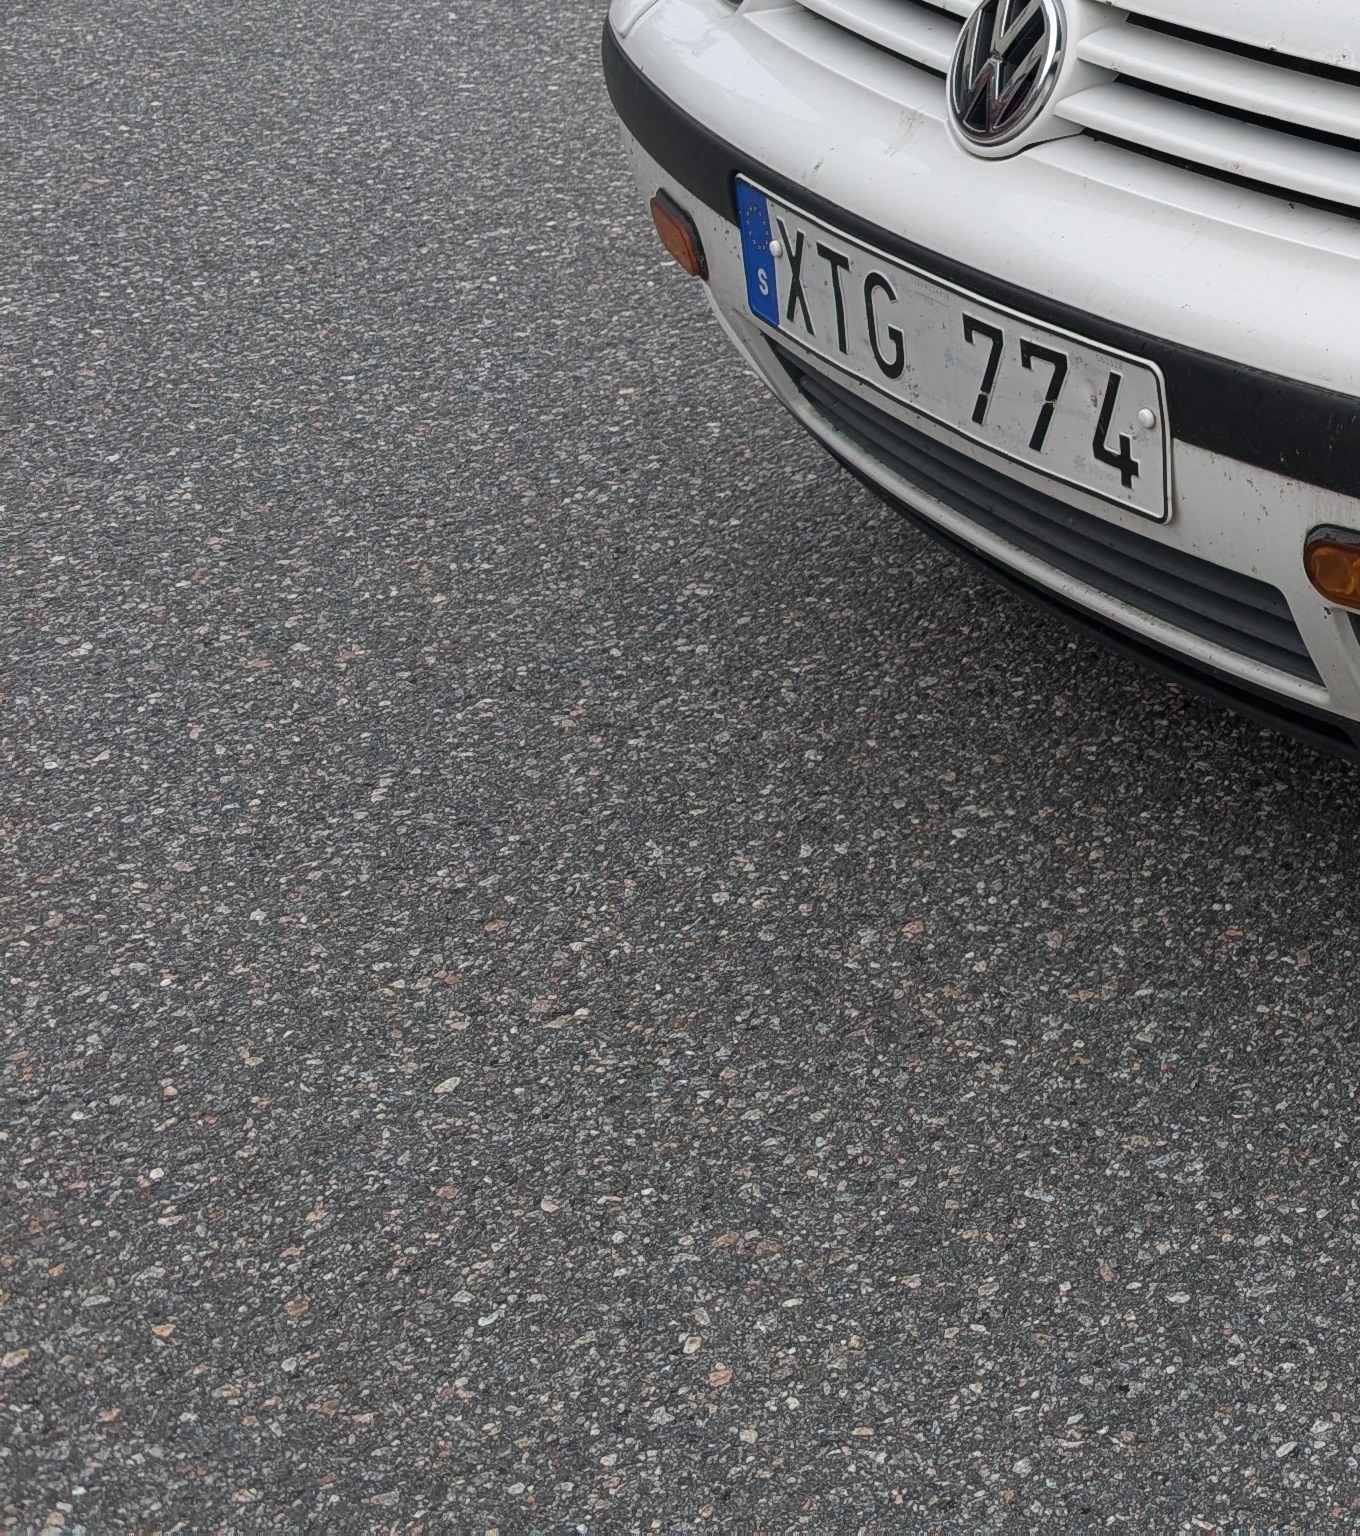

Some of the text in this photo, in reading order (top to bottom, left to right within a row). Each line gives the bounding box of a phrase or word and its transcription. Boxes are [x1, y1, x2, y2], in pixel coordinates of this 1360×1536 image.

[756, 267, 770, 296] S
[776, 216, 1140, 489] XTG 774
